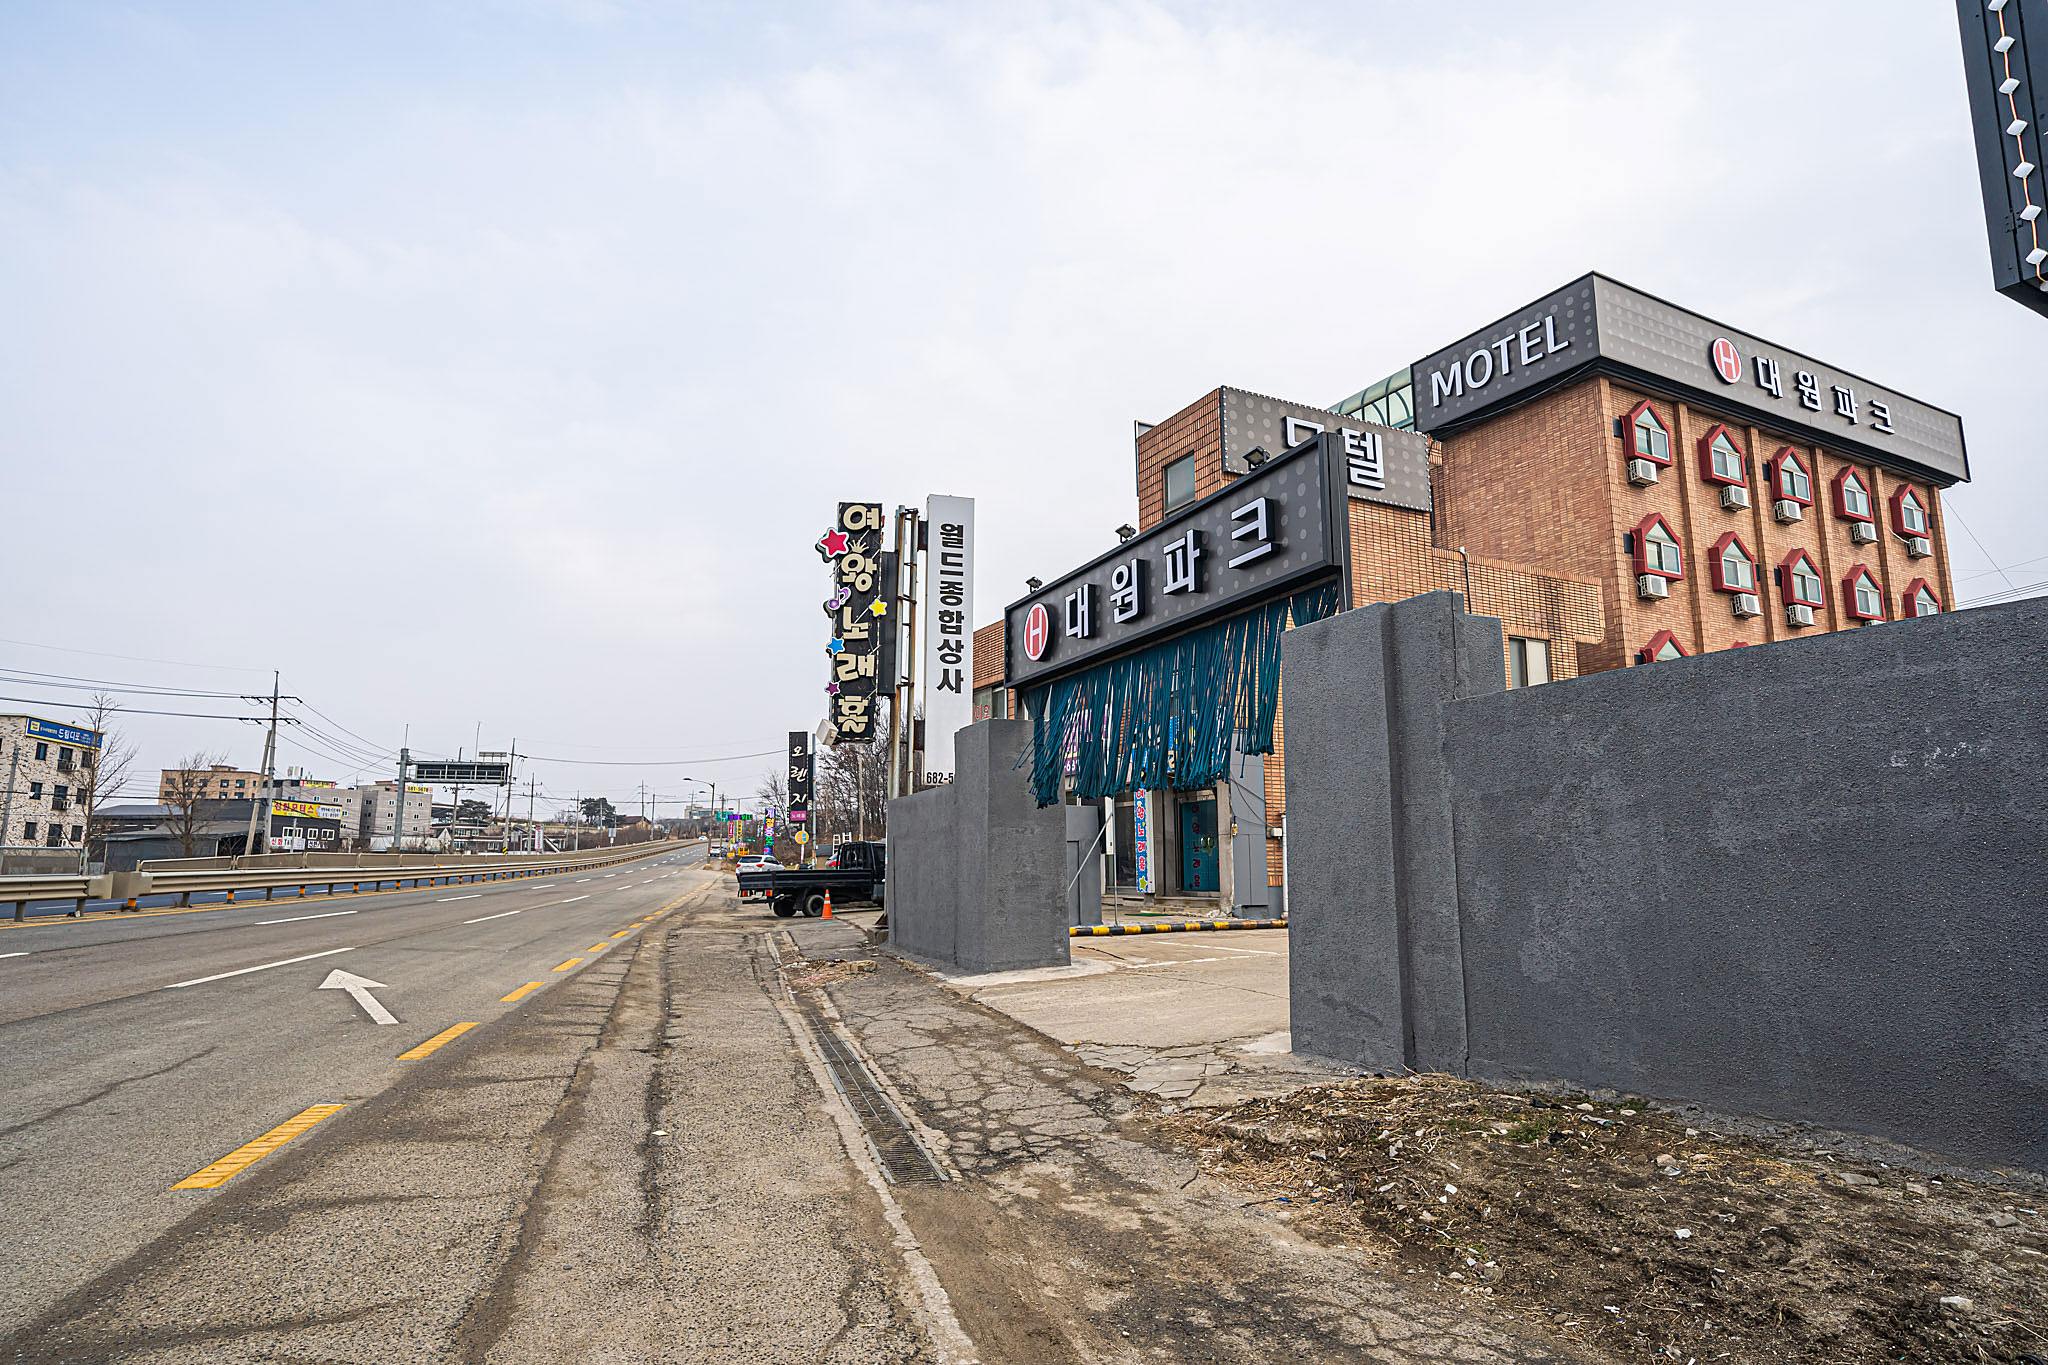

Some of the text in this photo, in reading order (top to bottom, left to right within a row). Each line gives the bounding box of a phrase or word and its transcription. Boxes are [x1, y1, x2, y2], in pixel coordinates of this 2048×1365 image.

[1430, 315, 1569, 407] MOTEL
[1756, 355, 1895, 434] 대원파크
[937, 523, 965, 694] 월드종합상사
[1064, 496, 1273, 639] 대원파크
[790, 745, 808, 805] 오렌지
